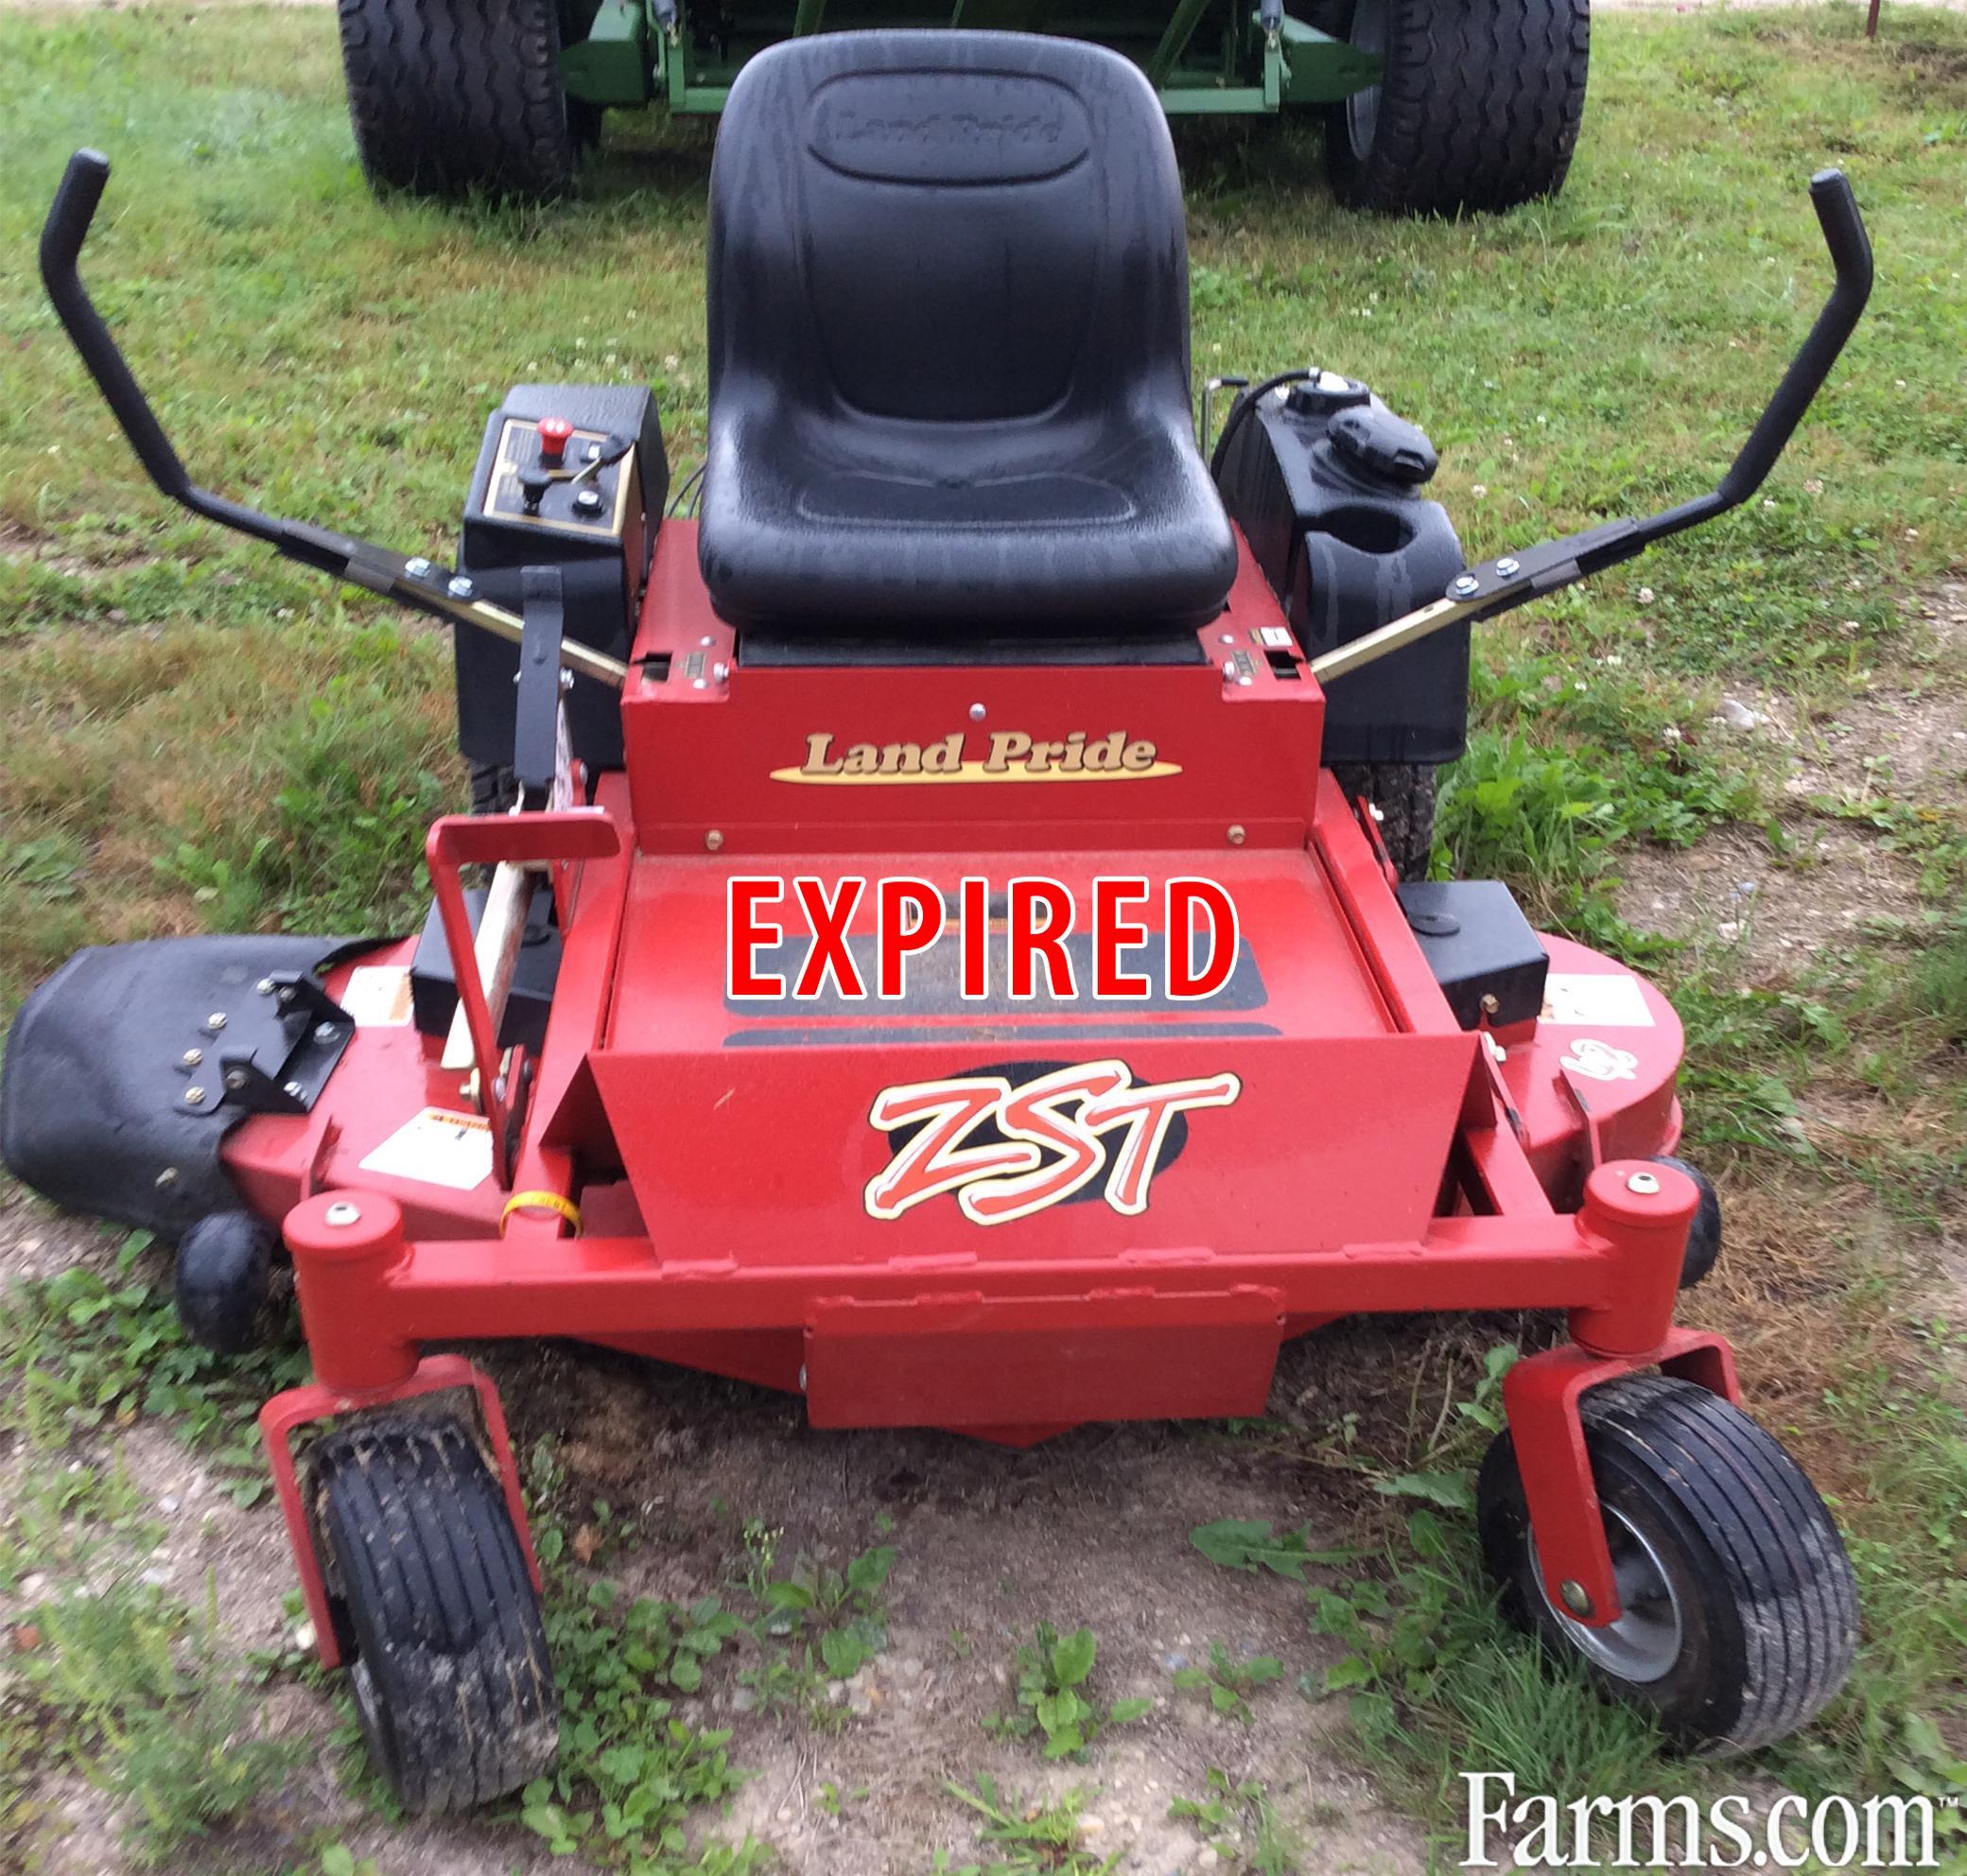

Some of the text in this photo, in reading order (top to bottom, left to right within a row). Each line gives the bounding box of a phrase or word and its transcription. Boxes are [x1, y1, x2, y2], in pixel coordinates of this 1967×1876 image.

[800, 730, 1158, 774] Land Pride
[863, 1058, 1243, 1226] ZST
